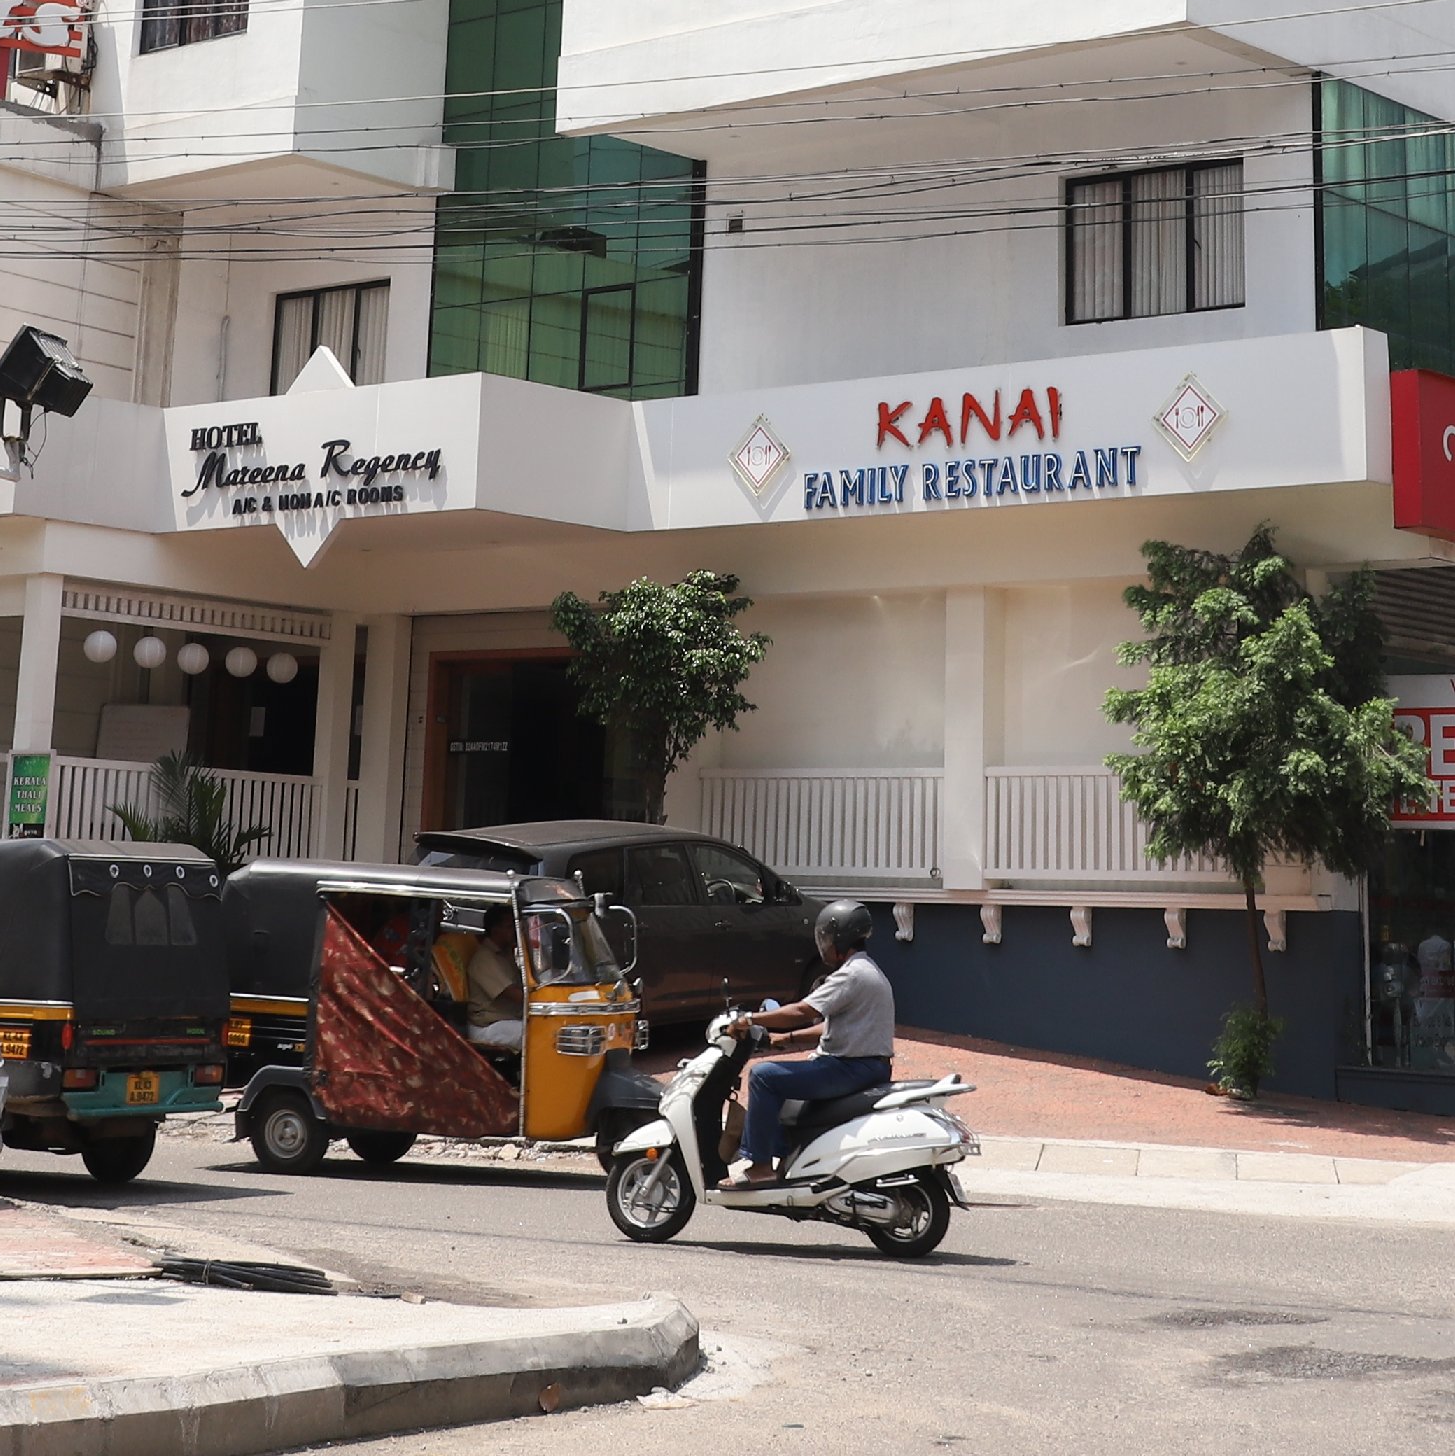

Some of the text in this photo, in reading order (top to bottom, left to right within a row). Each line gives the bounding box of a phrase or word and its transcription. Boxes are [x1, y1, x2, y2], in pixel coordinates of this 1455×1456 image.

[877, 387, 1060, 450] KANAI
[189, 422, 262, 451] HOTEL
[181, 439, 442, 498] Mareena Regency
[804, 446, 1142, 510] FAMILY RESTAURANT
[233, 486, 404, 514] A/C & NON A/C ROOMS
[14, 777, 46, 785] KERALA
[17, 790, 41, 799] THALI
[15, 804, 42, 812] MEALS
